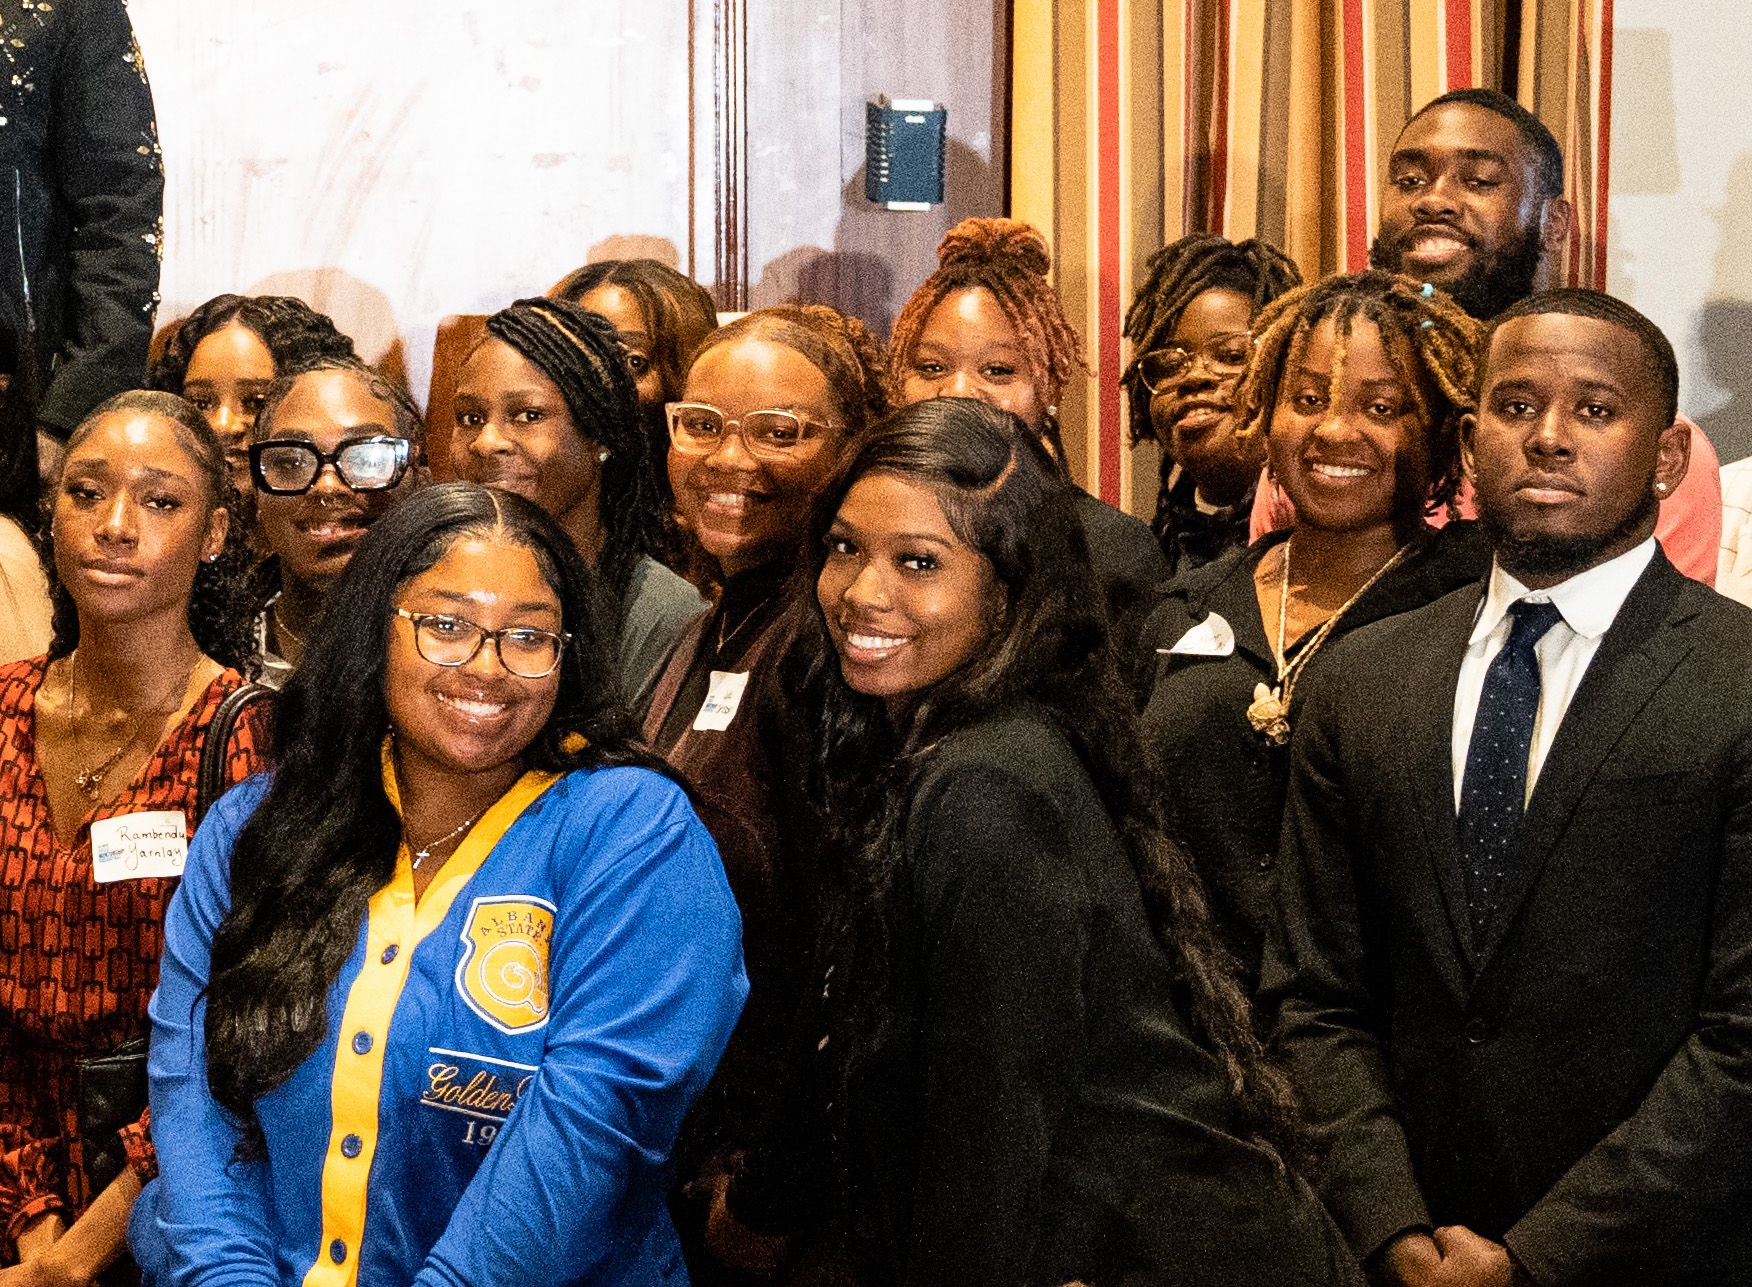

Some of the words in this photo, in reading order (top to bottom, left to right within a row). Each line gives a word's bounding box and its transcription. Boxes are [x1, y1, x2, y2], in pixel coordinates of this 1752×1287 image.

[481, 911, 550, 943] ALBAN
[423, 1063, 515, 1111] Golden
[461, 1120, 497, 1146] 19
